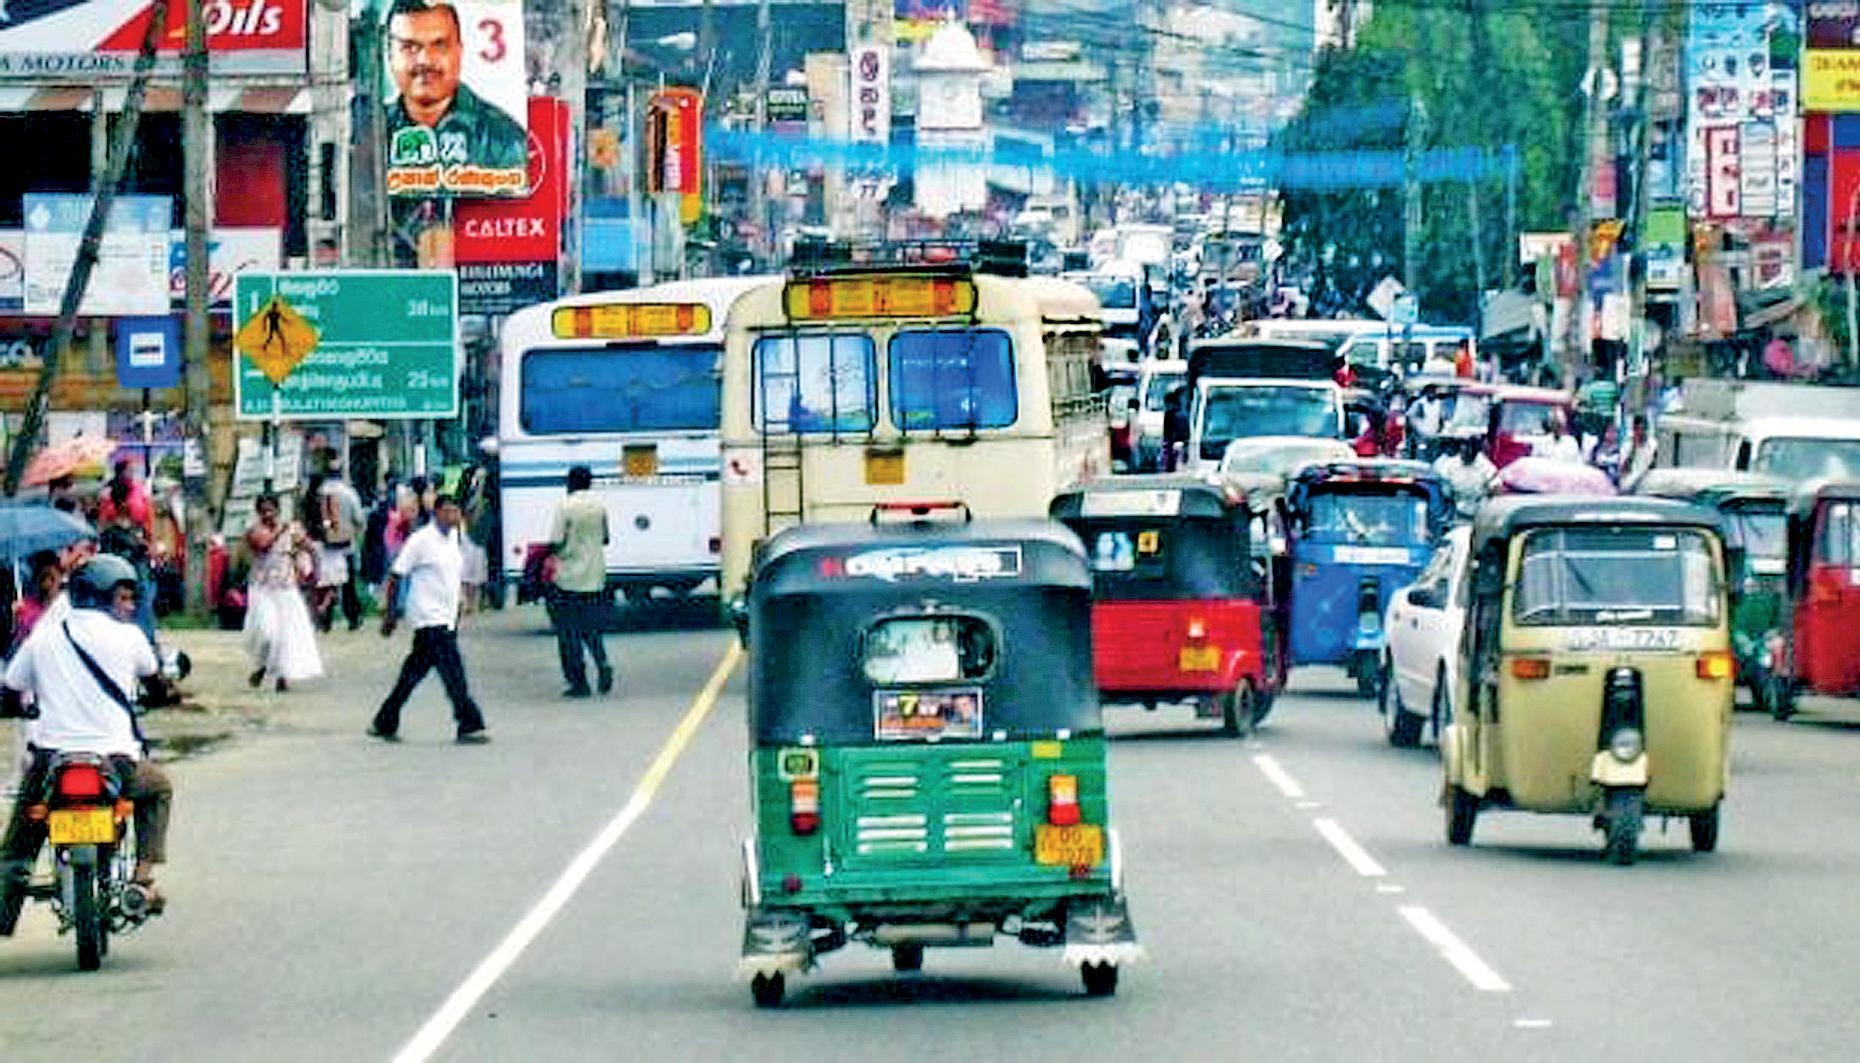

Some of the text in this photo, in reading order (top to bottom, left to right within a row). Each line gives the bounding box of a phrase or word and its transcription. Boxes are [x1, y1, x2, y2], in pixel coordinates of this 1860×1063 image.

[205, 0, 283, 35] Oils
[478, 18, 507, 62] 3
[20, 55, 125, 71] MOTORS
[464, 217, 546, 238] CALTEX
